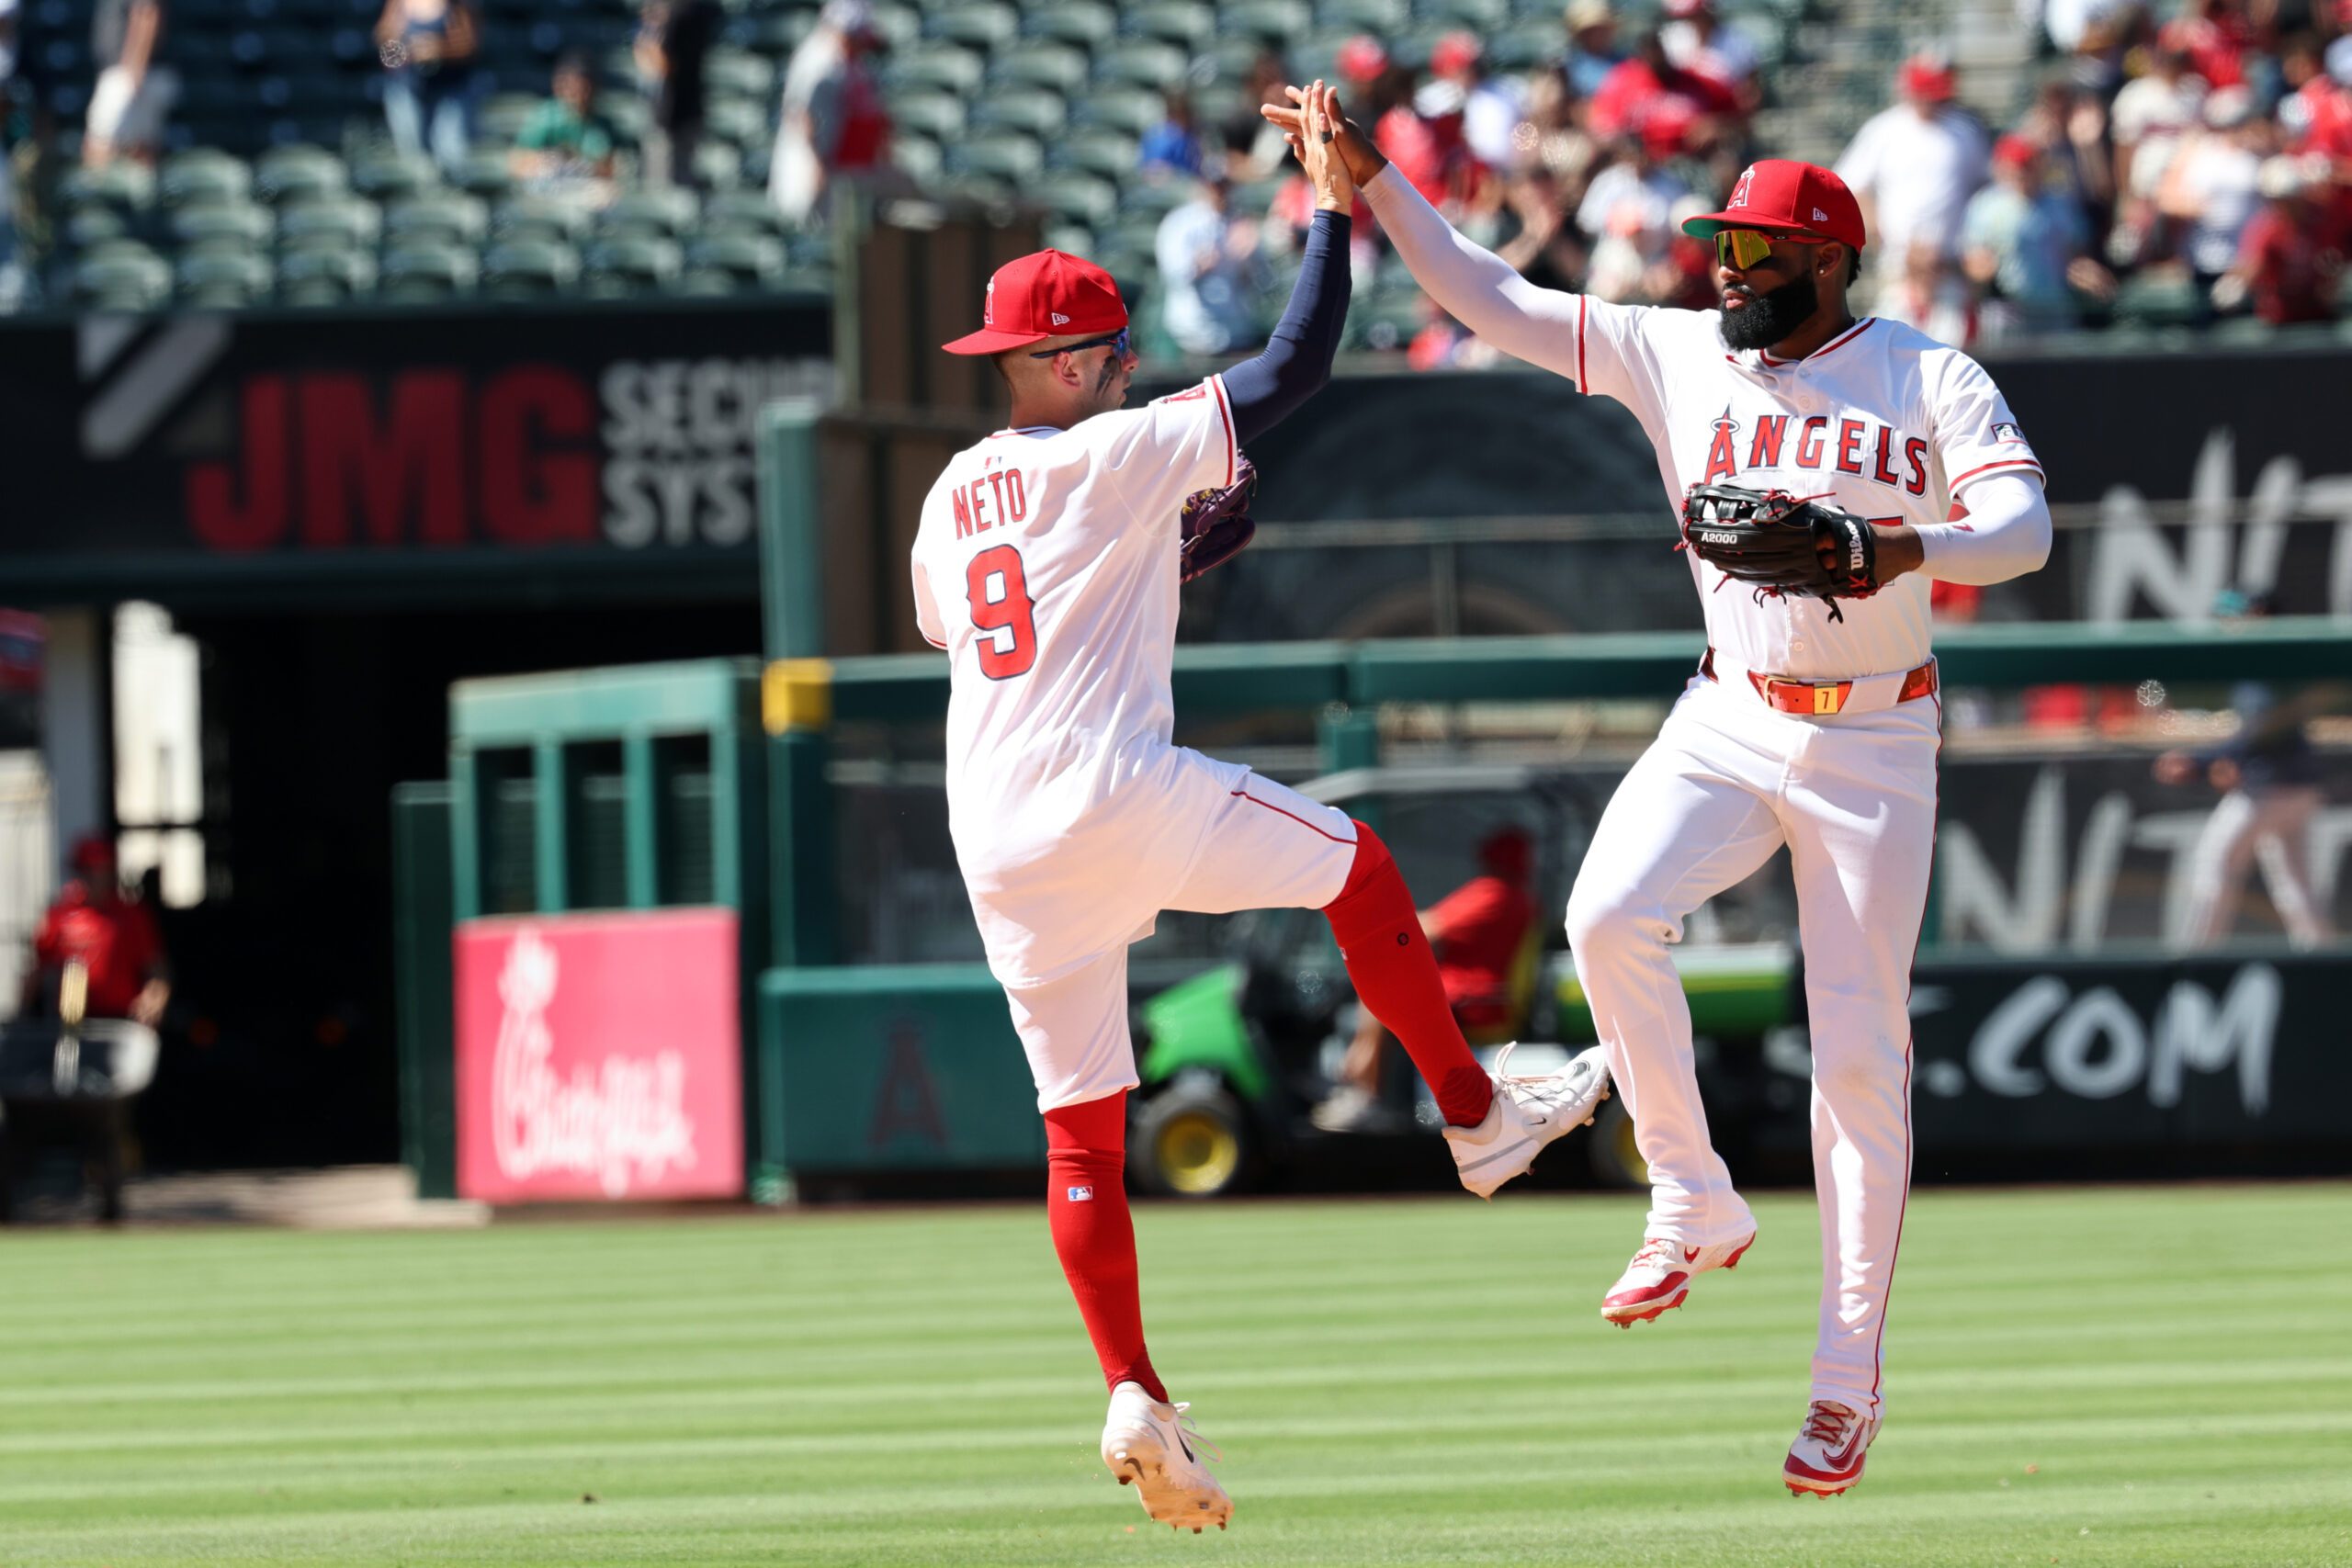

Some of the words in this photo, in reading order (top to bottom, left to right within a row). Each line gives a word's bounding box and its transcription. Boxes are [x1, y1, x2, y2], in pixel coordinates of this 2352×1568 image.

[190, 365, 598, 553] JMG
[1703, 400, 1930, 499] ANGELS
[602, 459, 759, 547] SYS
[952, 468, 1027, 541] NETO
[1702, 531, 1738, 545] A2000
[1844, 519, 1865, 570] Wilson
[966, 543, 1036, 681] 9
[1822, 691, 1830, 709] 7
[1911, 962, 2282, 1117] .COM
